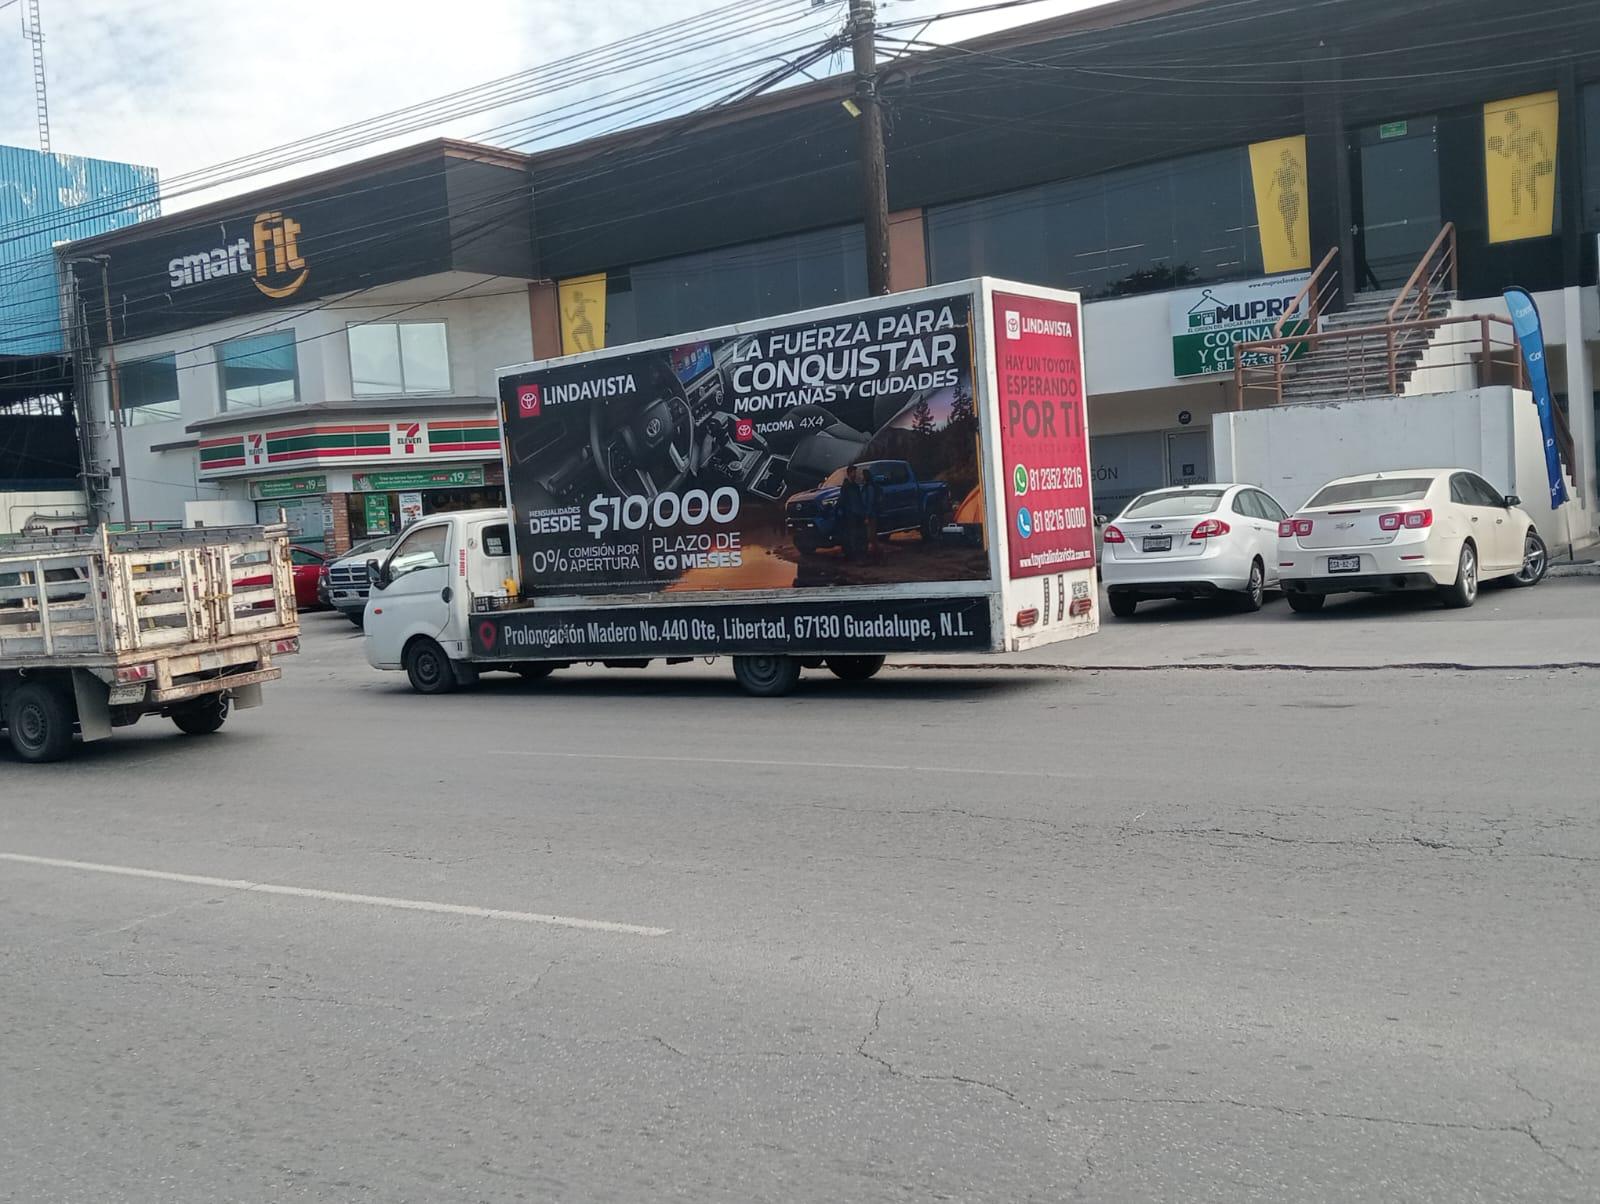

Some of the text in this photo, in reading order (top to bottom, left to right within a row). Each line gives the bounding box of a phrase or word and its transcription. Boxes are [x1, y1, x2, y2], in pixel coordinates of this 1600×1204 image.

[169, 212, 306, 287] smart fit
[1216, 296, 1300, 324] MUPRO
[732, 306, 955, 364] LA FUERZA PARA
[1022, 317, 1073, 337] LINDAVISTA
[1204, 326, 1283, 348] COCINA
[732, 333, 957, 394] CONQUISTAR
[1005, 354, 1076, 374] HAY UN TOYOTA
[1198, 349, 1209, 364] Y
[1217, 361, 1228, 371] 81
[543, 374, 637, 405] LINDAVISTA
[734, 369, 959, 414] MONTAÑAS Y CIUDADES
[1006, 374, 1077, 396] ESPERANDO
[756, 415, 824, 434] TACOMA 4X4
[1008, 399, 1081, 438] POR TI
[248, 434, 262, 465] 7
[396, 423, 420, 454] 7
[397, 437, 422, 445] ELEVEN
[1030, 467, 1083, 491] 81 2352 3216
[529, 487, 740, 539] MENSUALIDADES $10,000
[530, 515, 582, 534] DESDE
[1033, 507, 1087, 533] 81 8215 0000
[652, 532, 742, 553] PLAZO DE
[532, 542, 640, 573] 0% COMISIÓN POR
[569, 556, 640, 573] APERTURA
[653, 551, 743, 571] 60 MESES
[504, 612, 974, 648] Prolongación Madero No.440 Ote, Libertad, 67130 Guadalupe, N.L.
